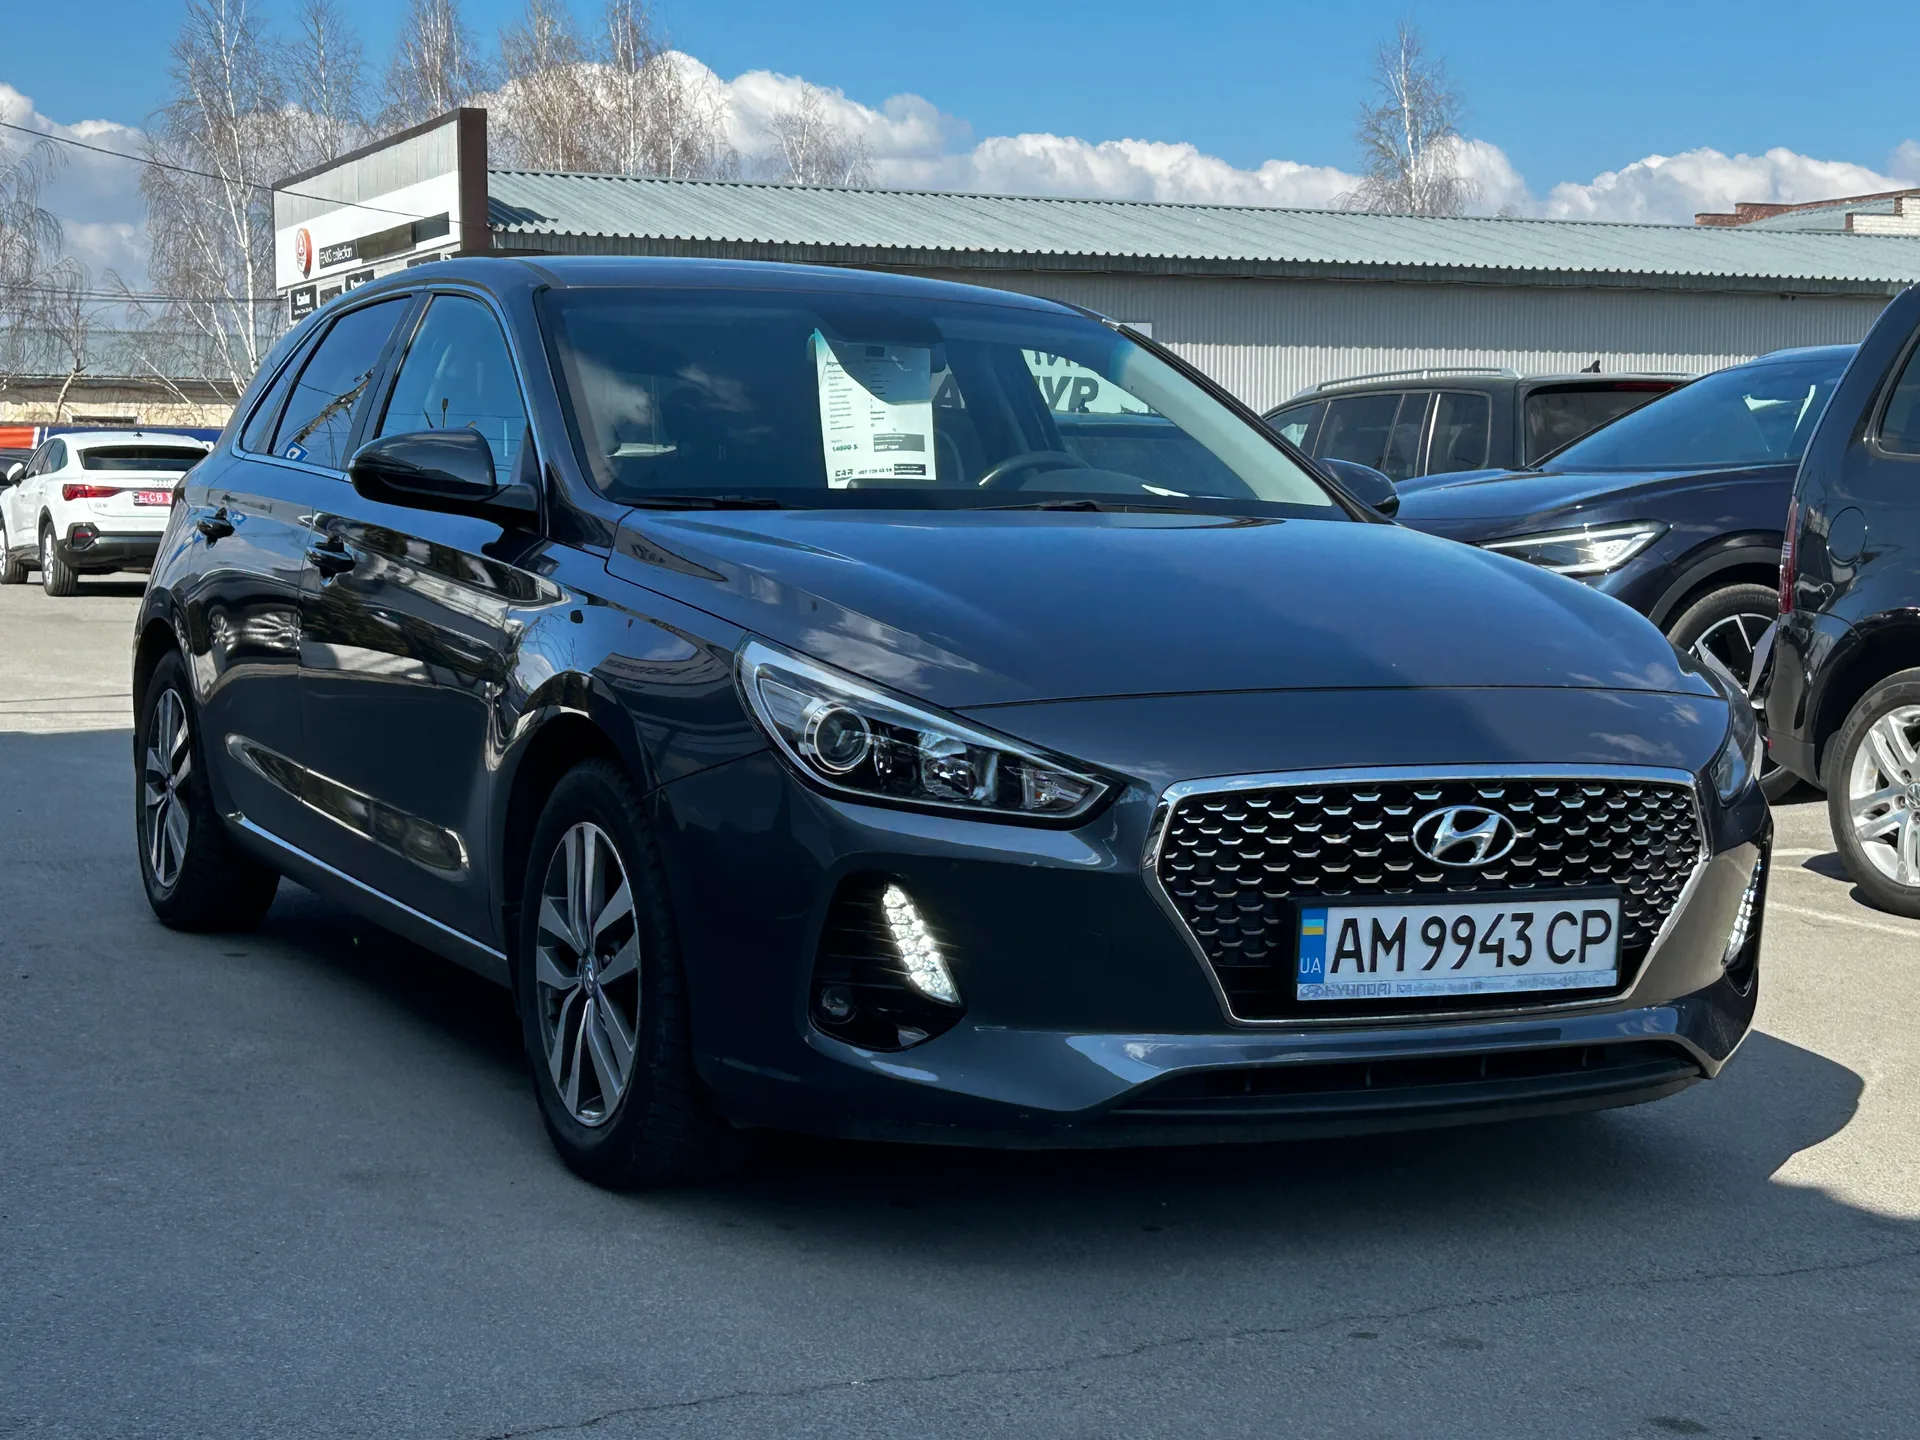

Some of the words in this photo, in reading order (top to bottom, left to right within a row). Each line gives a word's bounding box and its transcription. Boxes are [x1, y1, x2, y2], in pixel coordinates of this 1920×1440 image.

[835, 468, 854, 477] CAR
[1330, 916, 1407, 974] AM
[1421, 912, 1534, 971] 9943
[1546, 909, 1612, 964] CP
[1300, 957, 1322, 974] UA
[1324, 983, 1391, 997] HYUNDAI
